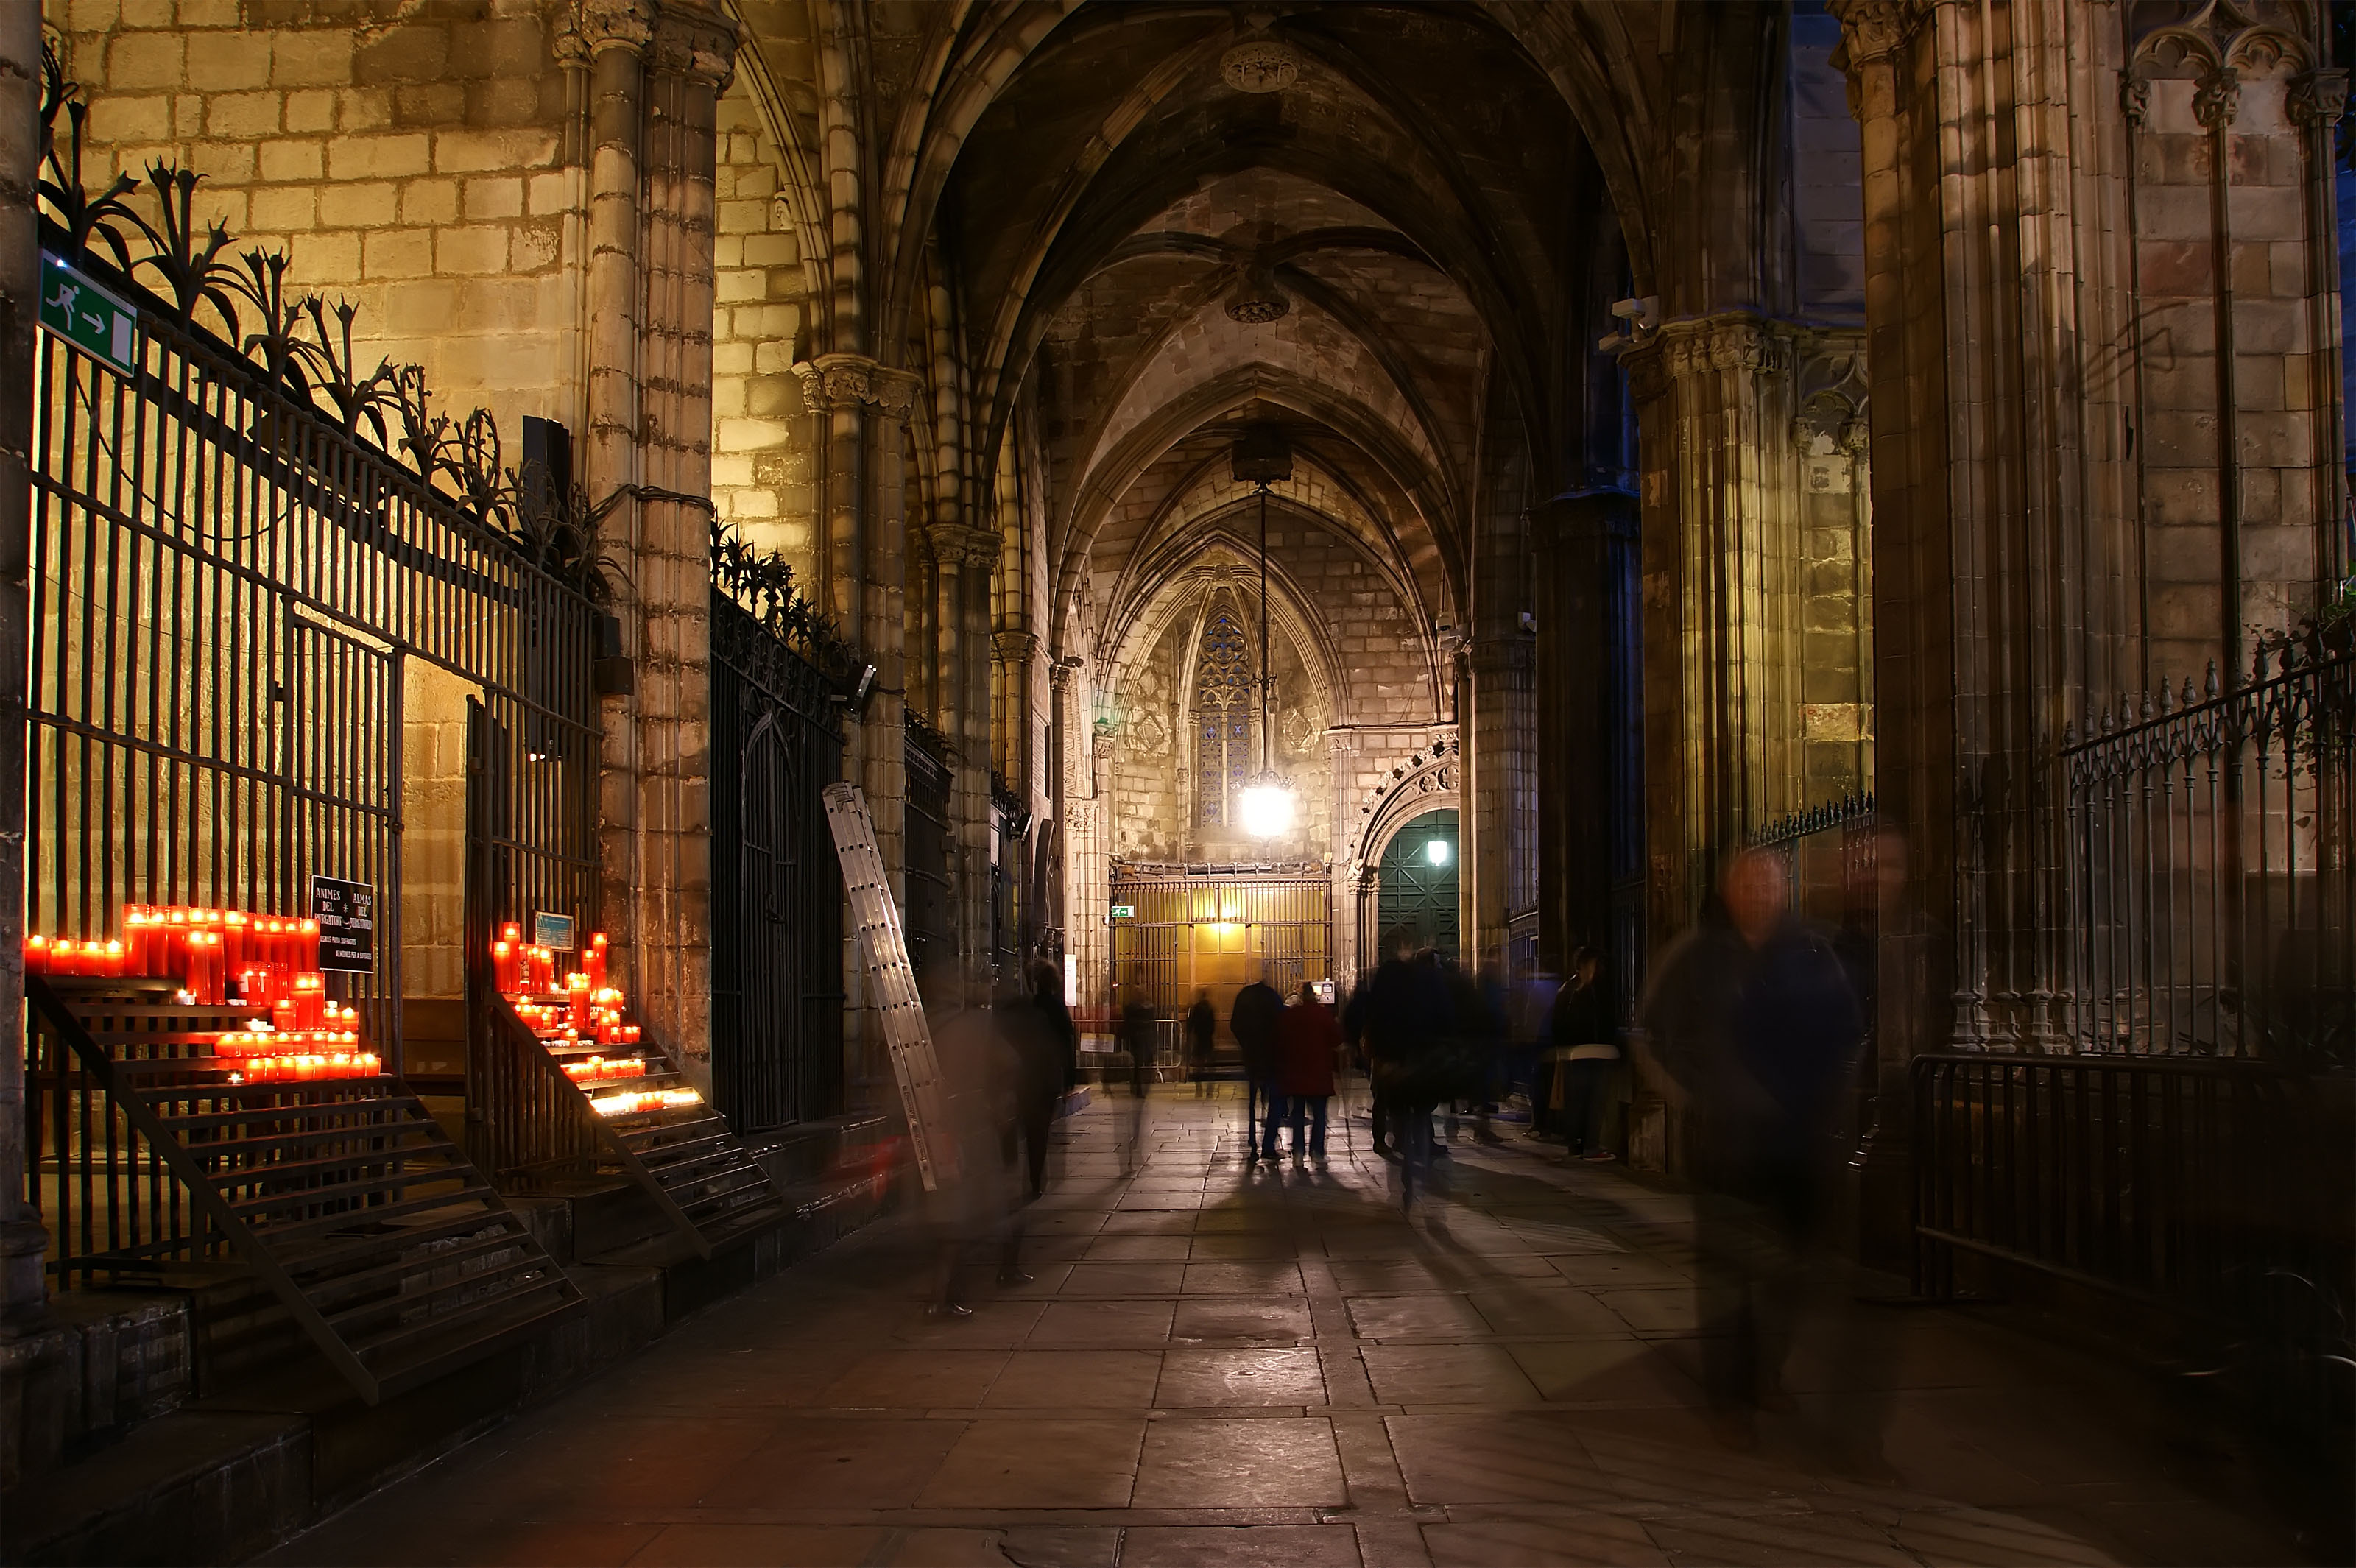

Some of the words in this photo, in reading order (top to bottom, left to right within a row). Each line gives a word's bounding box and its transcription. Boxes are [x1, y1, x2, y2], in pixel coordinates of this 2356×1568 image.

[316, 887, 341, 900] ANIMES
[353, 893, 371, 905] ALMAS
[322, 901, 334, 911] DEL
[358, 906, 367, 917] DEL
